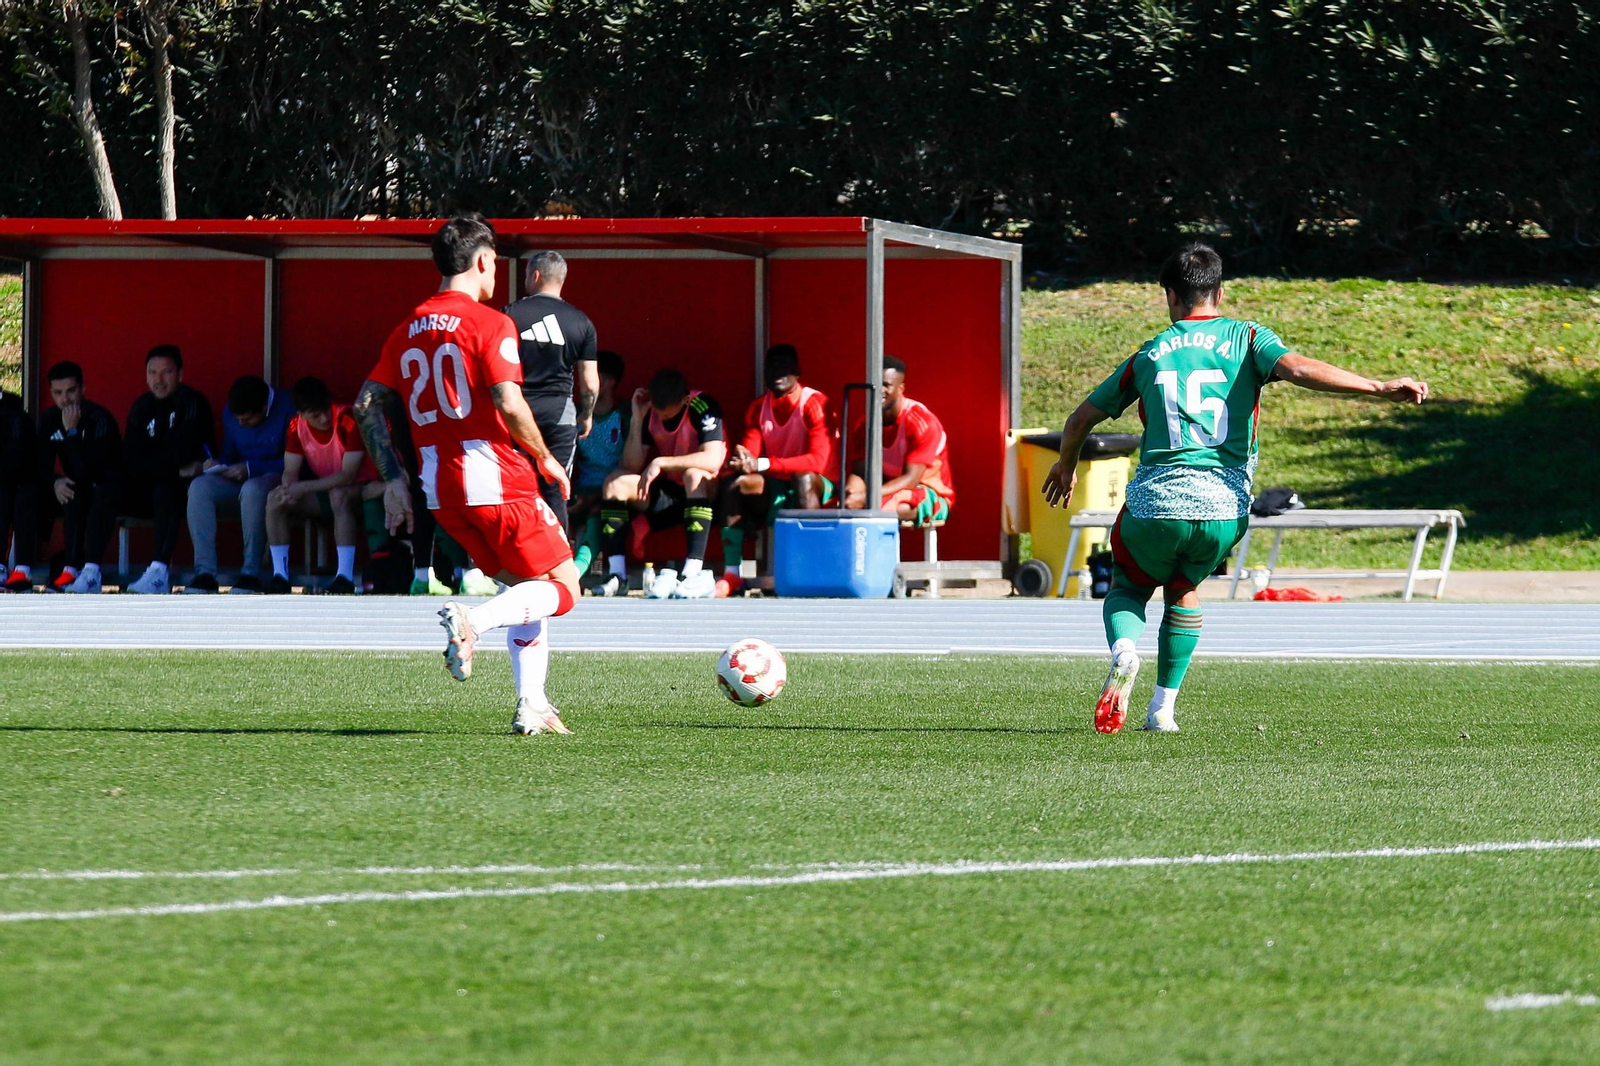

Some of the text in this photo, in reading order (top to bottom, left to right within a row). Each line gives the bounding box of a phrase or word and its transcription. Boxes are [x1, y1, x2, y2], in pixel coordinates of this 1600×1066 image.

[408, 314, 461, 338] MARSU
[1148, 332, 1232, 361] CARLOS A.
[400, 343, 472, 426] 20
[1154, 369, 1229, 450] 15
[855, 526, 867, 575] Coleman
